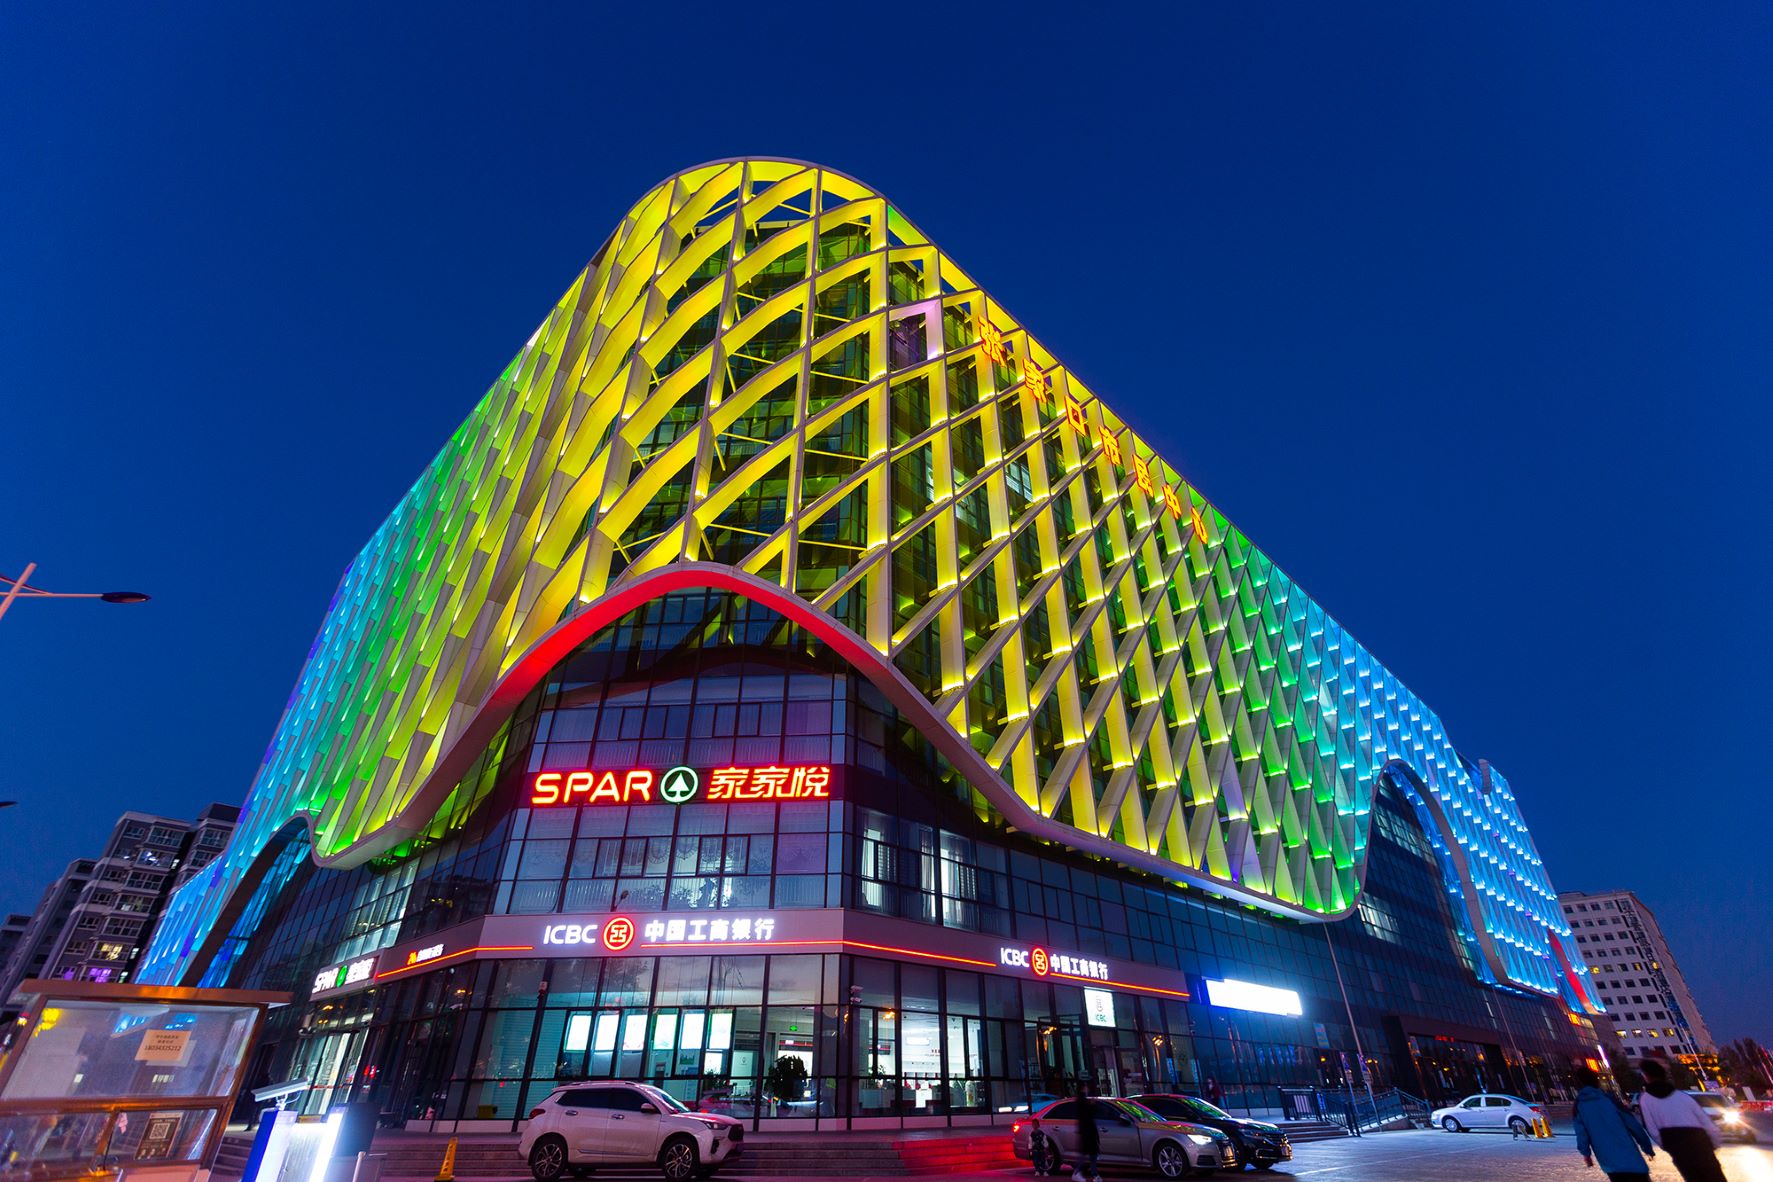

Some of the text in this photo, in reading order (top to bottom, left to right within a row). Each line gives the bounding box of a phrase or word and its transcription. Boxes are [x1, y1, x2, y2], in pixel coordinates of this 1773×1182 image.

[978, 315, 1208, 544] 张家口市民中心
[532, 766, 830, 804] SPAR 家家悦
[543, 917, 775, 945] ICBC 中国工商银行
[312, 967, 339, 993] SPAR
[1000, 947, 1109, 980] ICBC 中国工商银行
